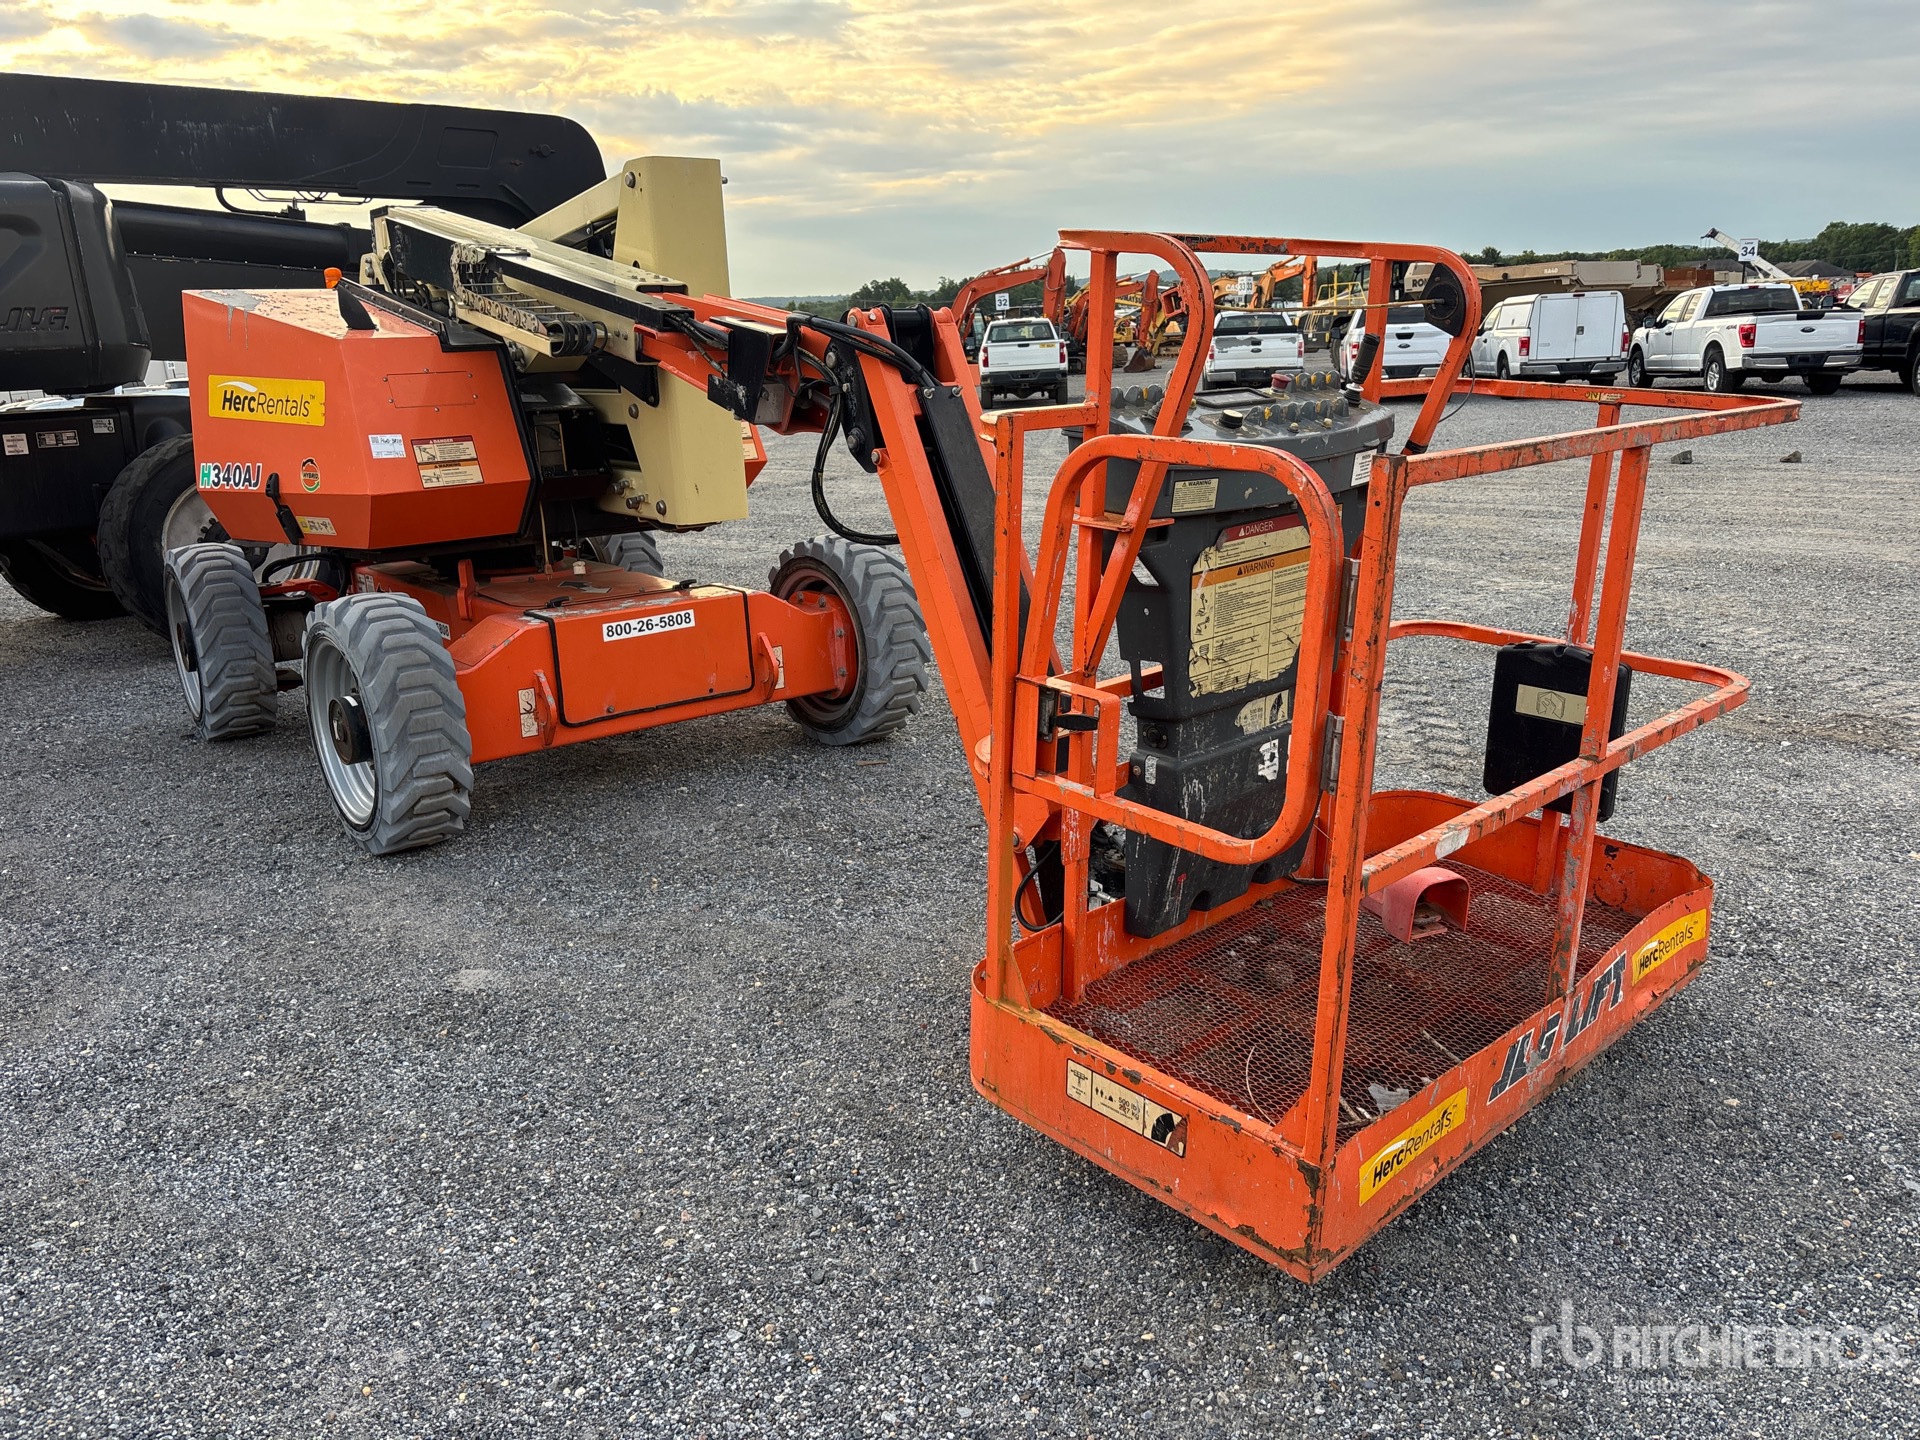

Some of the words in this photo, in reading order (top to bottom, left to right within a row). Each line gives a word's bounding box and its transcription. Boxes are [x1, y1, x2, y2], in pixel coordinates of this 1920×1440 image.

[1741, 246, 1756, 257] 34
[997, 299, 1008, 307] 32
[0, 307, 69, 332] JLG
[200, 463, 262, 490] H340AJ
[302, 472, 319, 480] HYBRID
[1245, 520, 1275, 536] DANGER
[1242, 558, 1275, 575] WARNING
[606, 612, 692, 637] 800-26-5808
[1561, 950, 1627, 1048] LIFT
